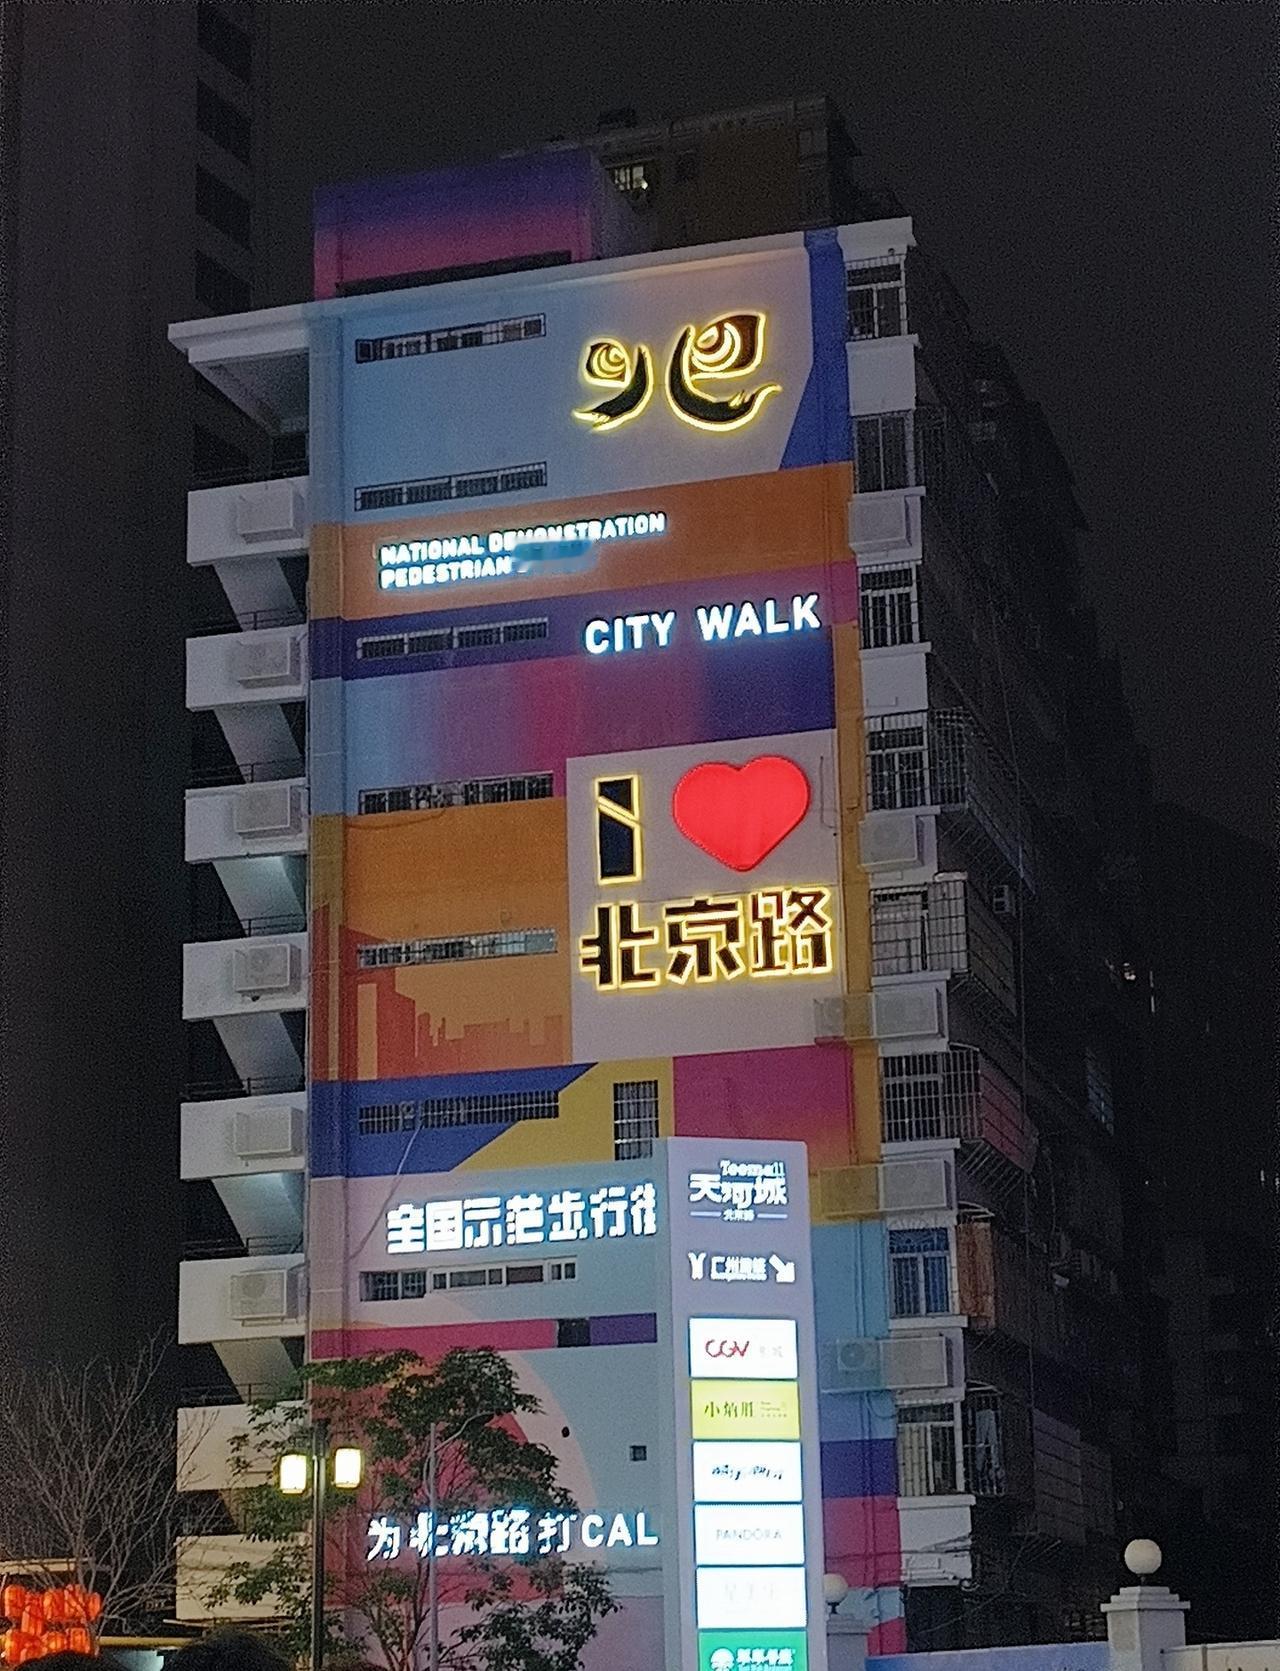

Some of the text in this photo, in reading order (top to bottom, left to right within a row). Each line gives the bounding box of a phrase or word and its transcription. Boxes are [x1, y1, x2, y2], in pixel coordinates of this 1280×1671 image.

[381, 536, 484, 565] NATIONAL
[381, 556, 512, 588] PEDESTRIAN
[585, 594, 821, 653] CITY WALK
[578, 886, 833, 992] 北京路
[689, 1174, 787, 1210] 天河城
[705, 1339, 750, 1358] CGV
